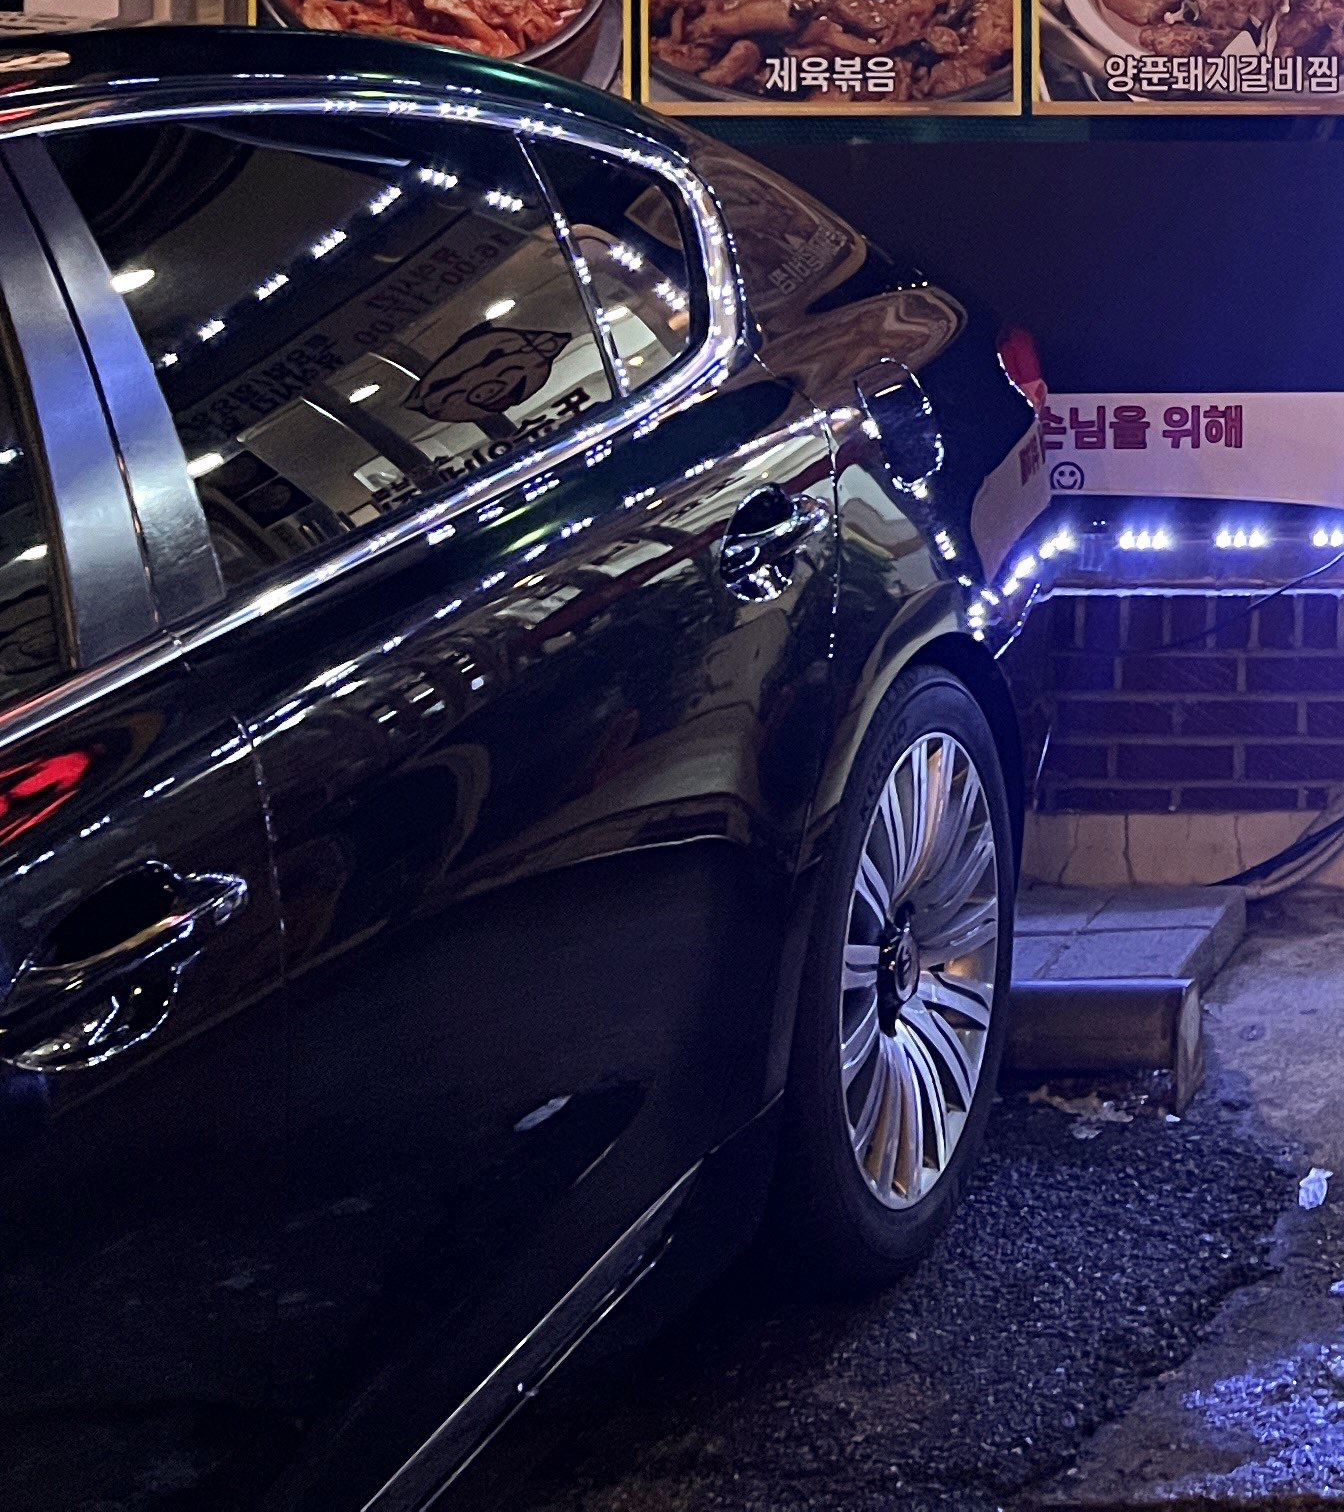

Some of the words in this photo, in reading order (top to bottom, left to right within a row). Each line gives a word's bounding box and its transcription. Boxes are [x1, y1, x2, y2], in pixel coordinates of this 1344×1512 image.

[765, 57, 896, 94] 제육볶음
[1105, 55, 1340, 93] 양푼돼지갈비찜
[1162, 404, 1244, 449] 위해
